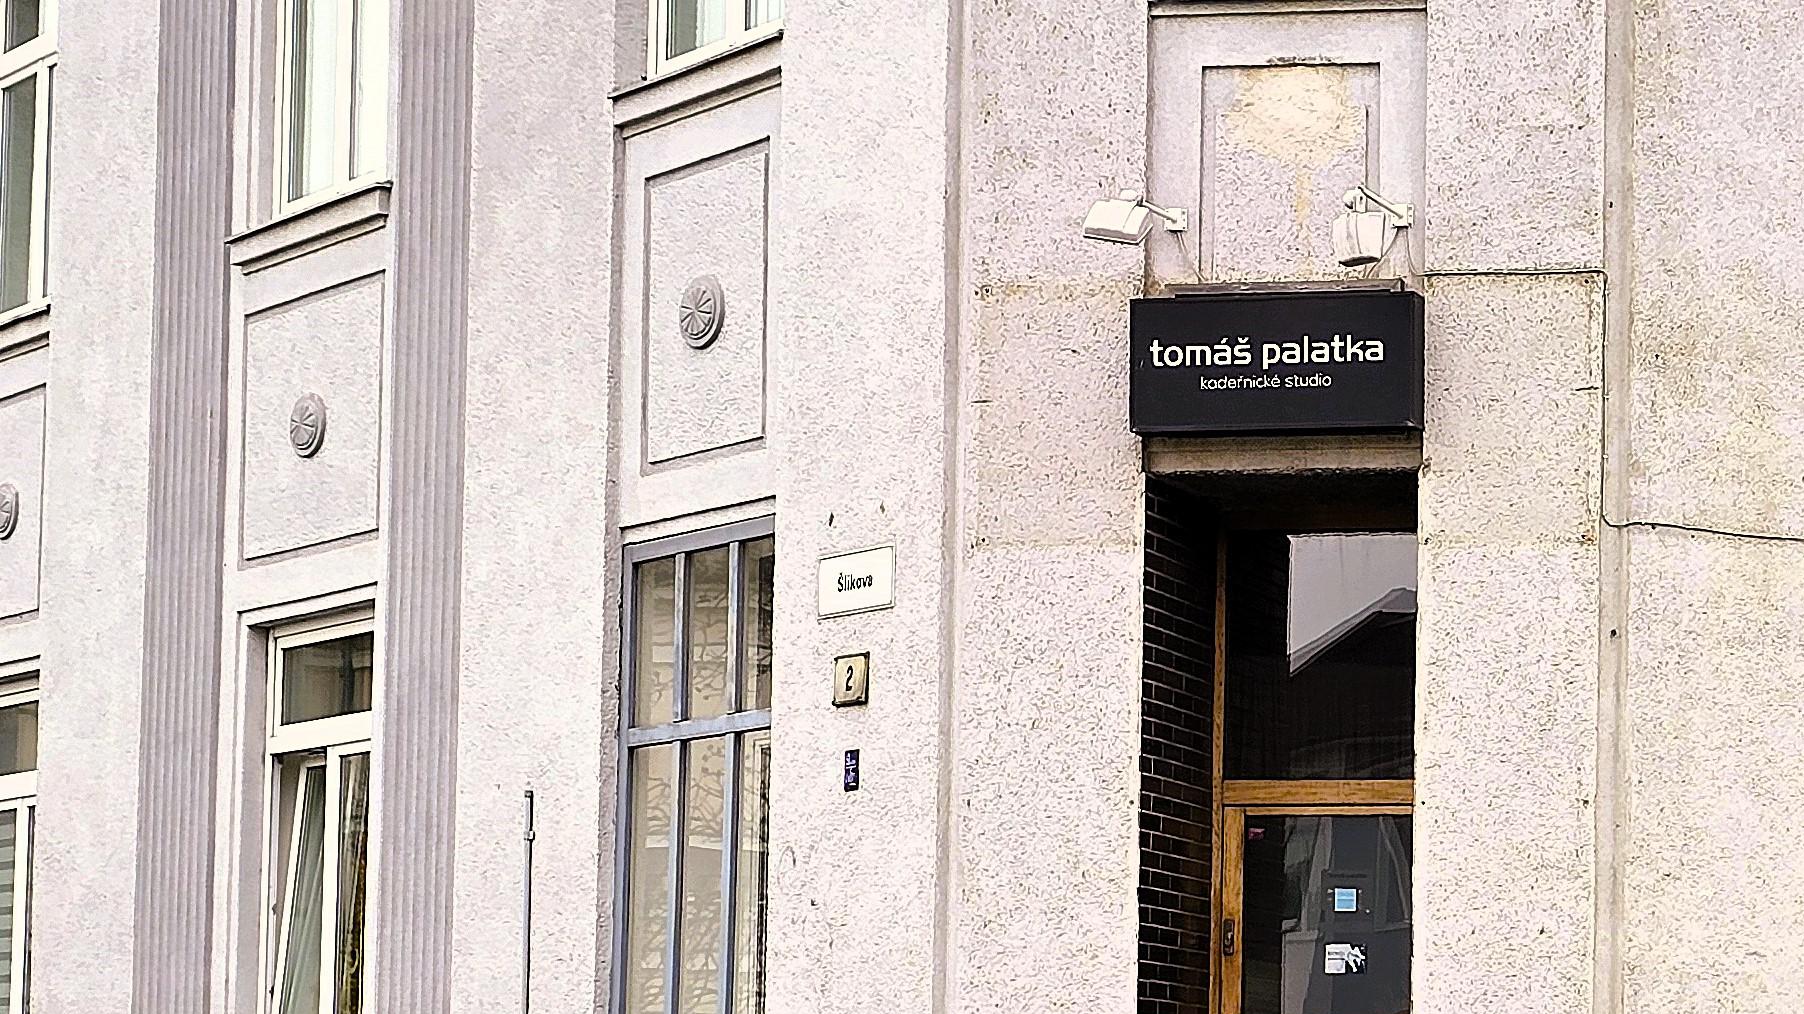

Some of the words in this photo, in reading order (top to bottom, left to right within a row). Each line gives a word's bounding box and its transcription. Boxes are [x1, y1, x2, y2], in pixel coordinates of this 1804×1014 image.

[1150, 336, 1252, 367] tomáš
[1262, 334, 1385, 370] palatka
[1284, 372, 1332, 388] studio
[845, 664, 854, 692] 2
